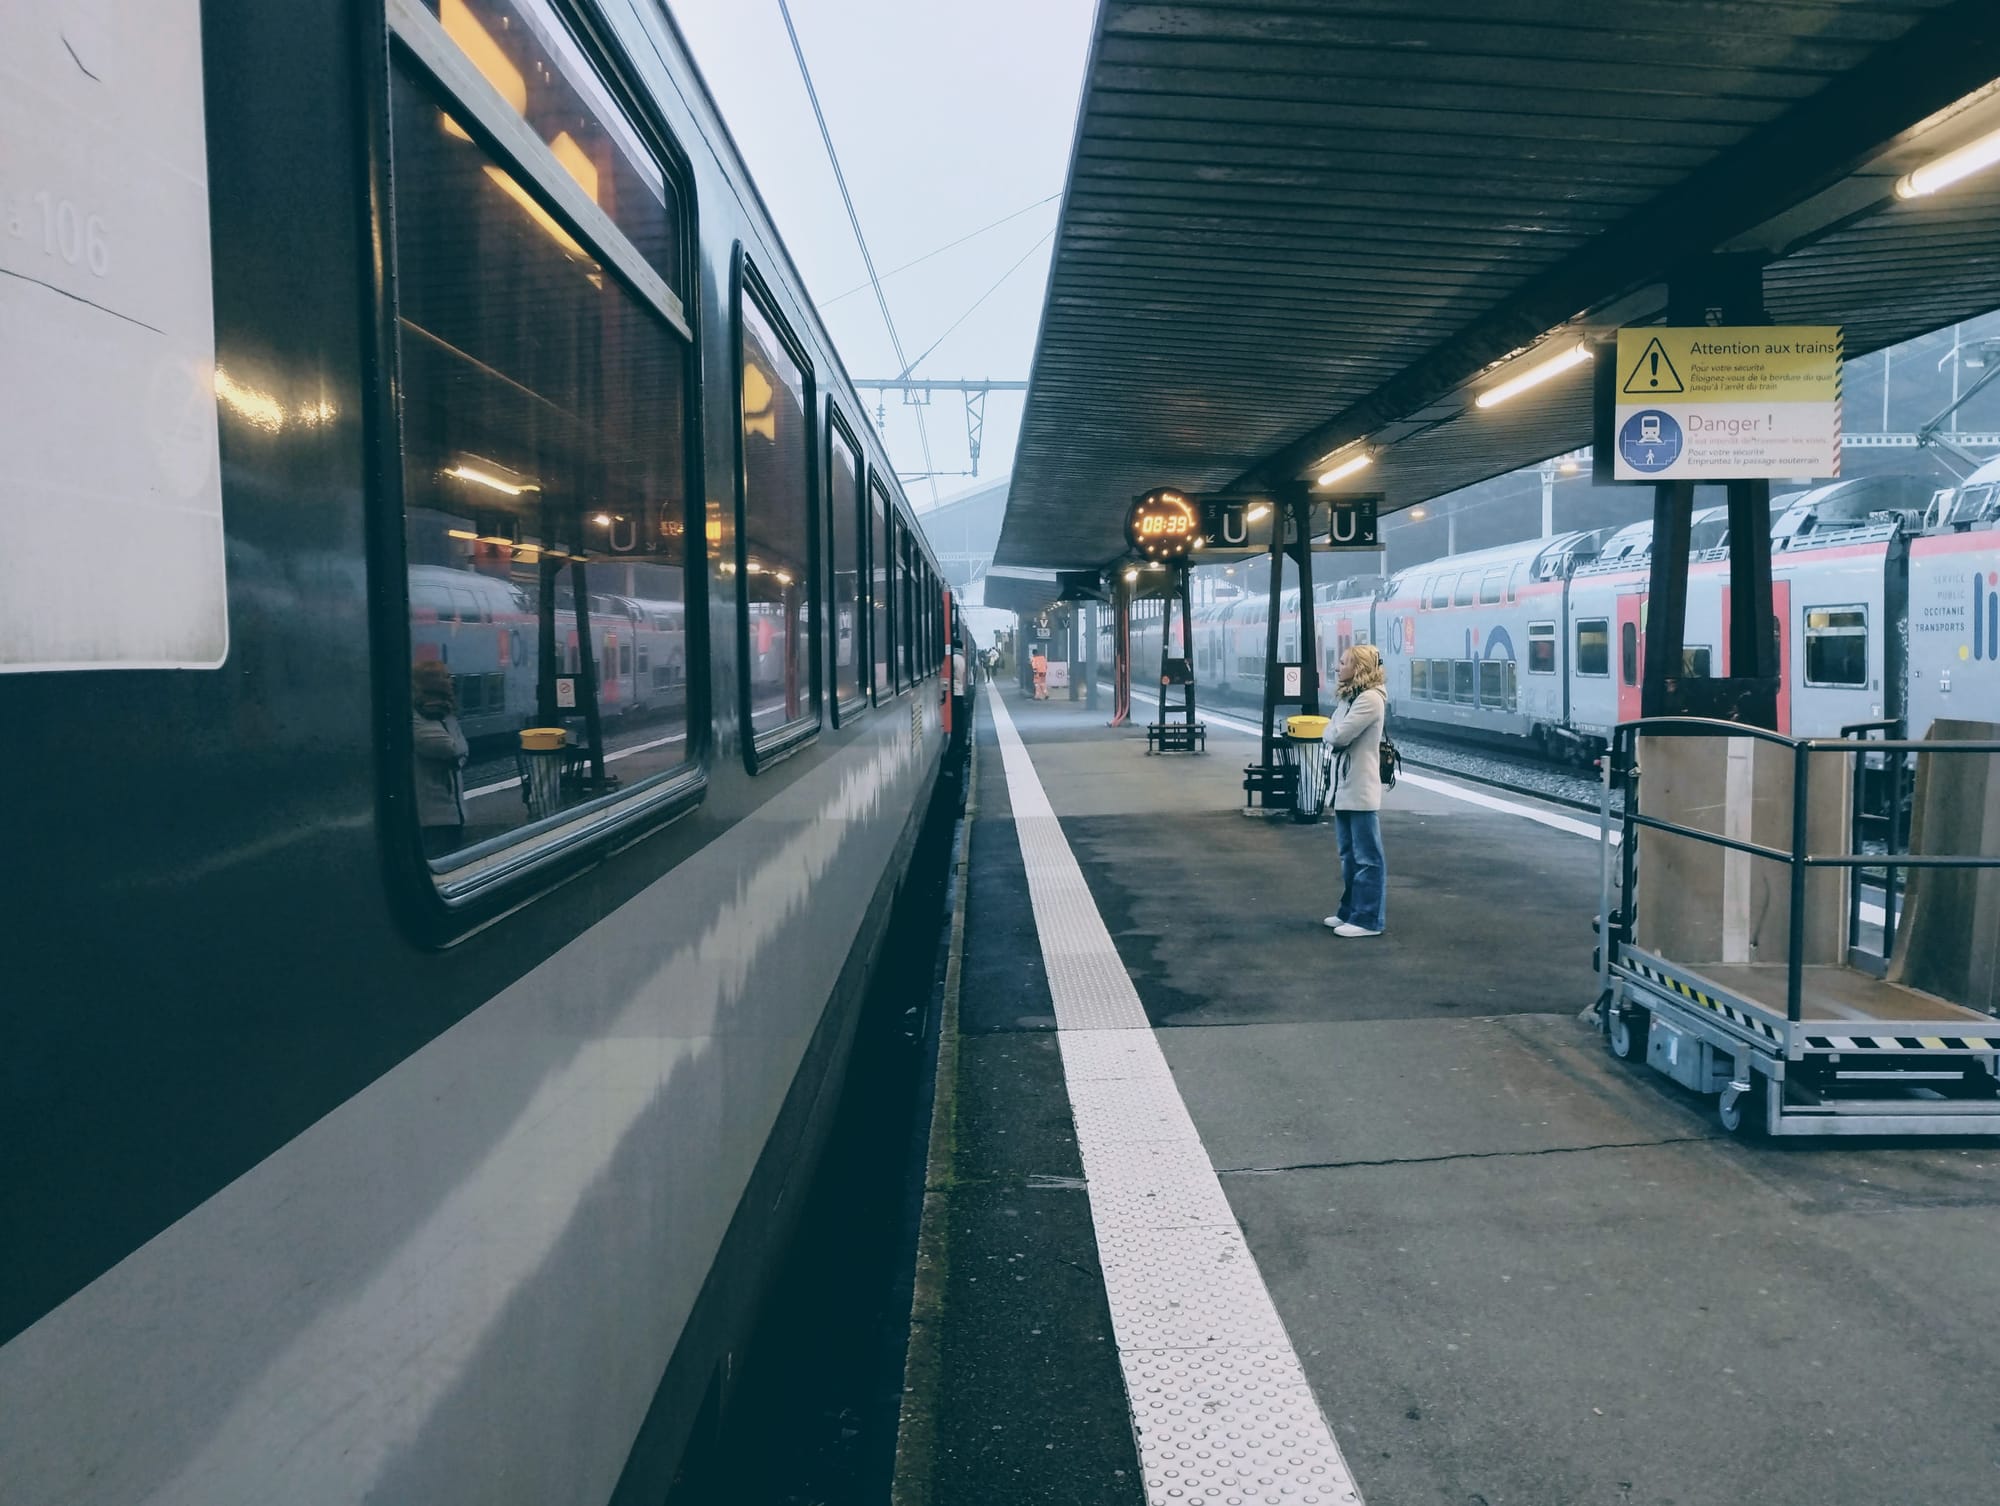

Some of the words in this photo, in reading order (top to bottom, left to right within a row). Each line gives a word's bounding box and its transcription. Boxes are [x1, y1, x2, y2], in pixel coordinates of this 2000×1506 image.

[33, 191, 109, 278] 106
[1690, 341, 1760, 355] Attention
[1764, 343, 1790, 354] aux
[1796, 341, 1835, 353] trains
[1690, 364, 1710, 372] Pour
[1747, 374, 1758, 382] de
[1688, 414, 1760, 436] Danger
[1768, 414, 1773, 431] !
[1142, 515, 1188, 533] 08:39
[1223, 513, 1247, 543] U
[1332, 511, 1356, 542] U
[1934, 575, 1965, 584] SERVICE
[1924, 607, 1965, 616] OCCITANIE
[1915, 623, 1965, 632] TRANSPORTS
